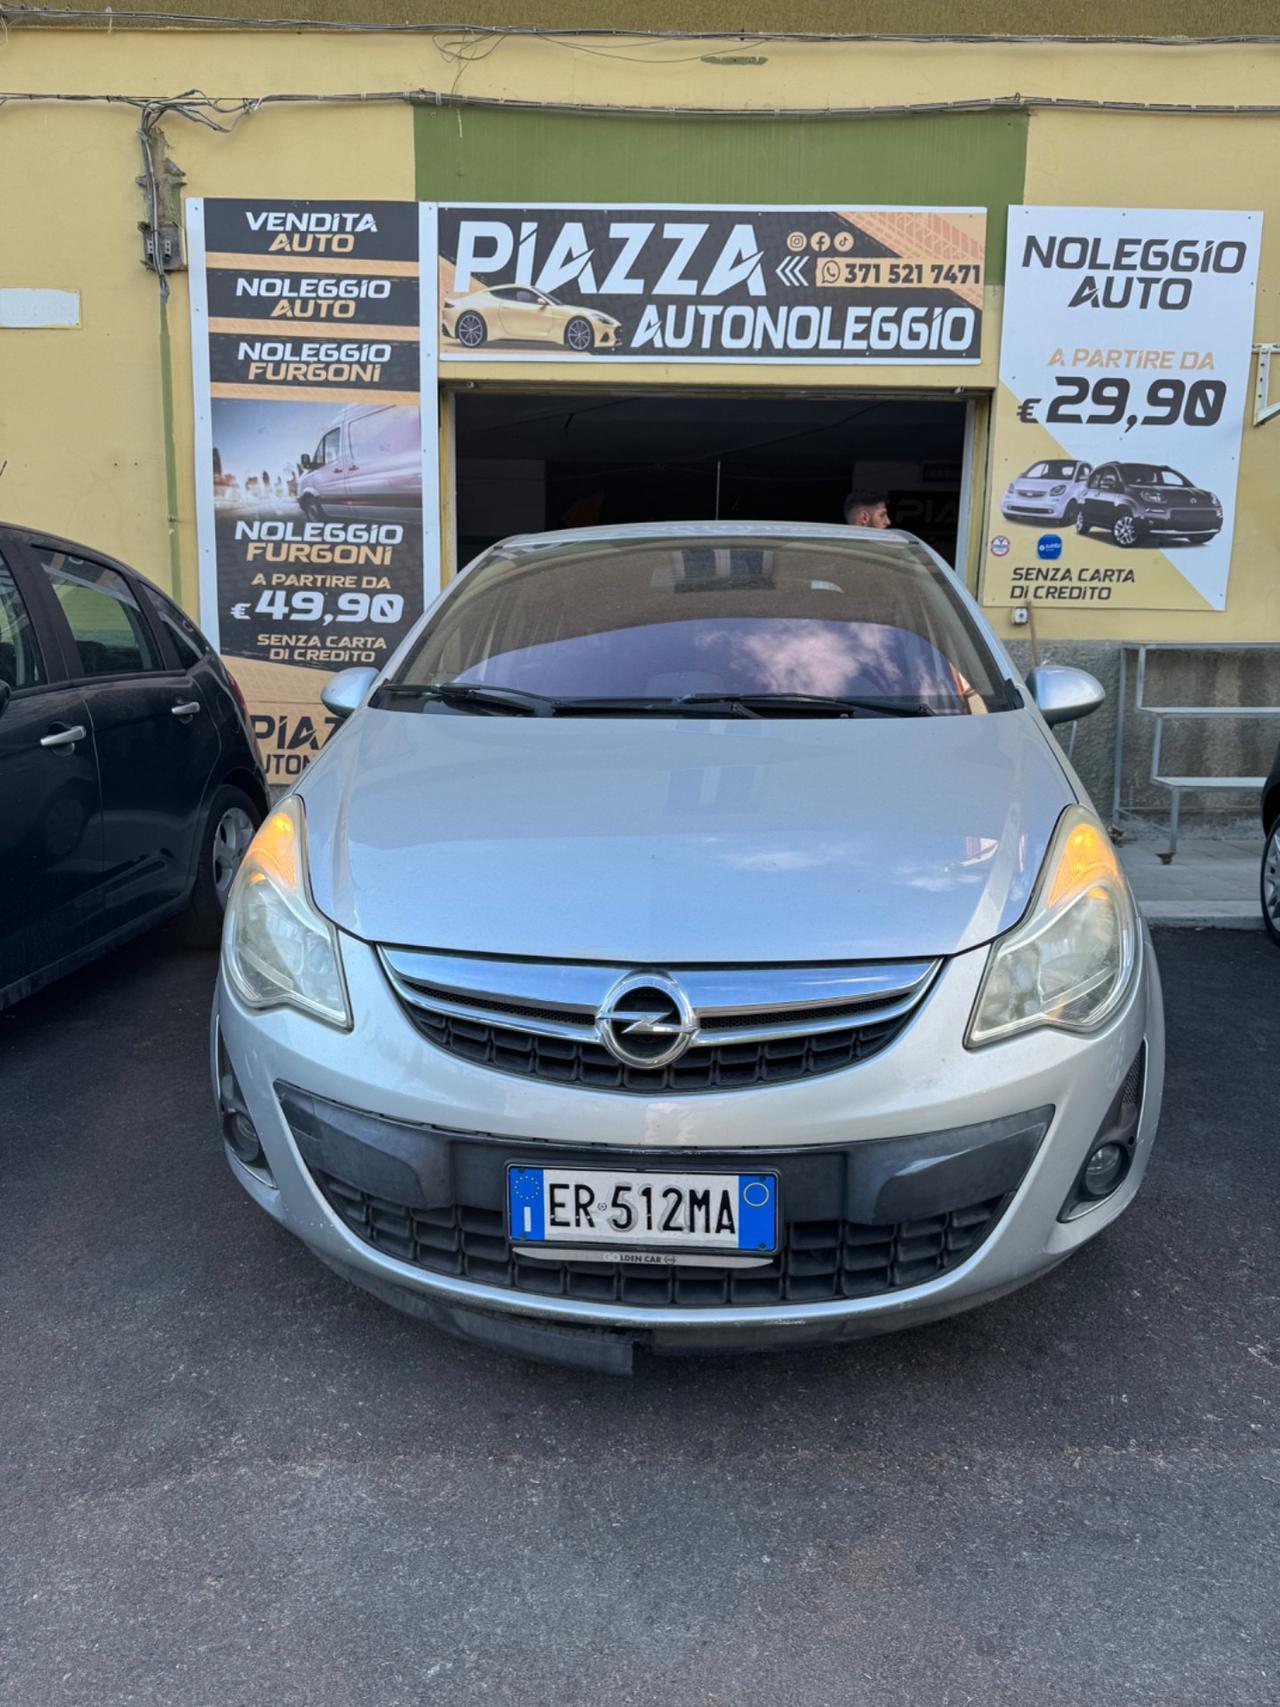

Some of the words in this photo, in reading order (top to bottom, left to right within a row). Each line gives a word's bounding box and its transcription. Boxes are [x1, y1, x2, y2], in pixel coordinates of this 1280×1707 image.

[245, 212, 378, 232] VENDITA
[268, 233, 355, 252] AUTO
[453, 220, 767, 296] PIAZZA
[1022, 235, 1247, 274] NOLEGGIO
[844, 263, 881, 283] 371
[888, 264, 923, 283] 521
[930, 264, 980, 284] 7471
[236, 278, 391, 299] NOLEGGIO
[1067, 275, 1193, 310] AUTO
[270, 299, 356, 318] AUTO
[630, 304, 975, 351] AUTONOLEGGIO
[237, 342, 392, 362] NOLEGGIO
[1047, 347, 1065, 367] A
[1072, 349, 1175, 369] PARTIRE
[1179, 351, 1215, 370] DA
[248, 362, 381, 382] FURGONI
[1016, 398, 1042, 424] €
[1046, 376, 1227, 433] 29,90
[234, 520, 404, 545] NOLEGGIO
[246, 542, 393, 566] FURGONI
[251, 573, 267, 586] A
[271, 574, 357, 588] PARTIRE
[361, 576, 391, 589] DA
[1011, 567, 1073, 582] SENZA
[1077, 568, 1135, 583] CARTA
[1009, 585, 1029, 599] DI
[1033, 586, 1112, 601] CREDITO
[230, 602, 252, 620] €
[254, 589, 404, 626] 49,90
[257, 634, 321, 647] SENZA
[325, 635, 387, 649] CARTA
[269, 649, 289, 660] DI
[293, 650, 376, 663] CREDITO
[549, 1183, 596, 1228] ER
[610, 1184, 736, 1234] 512MA
